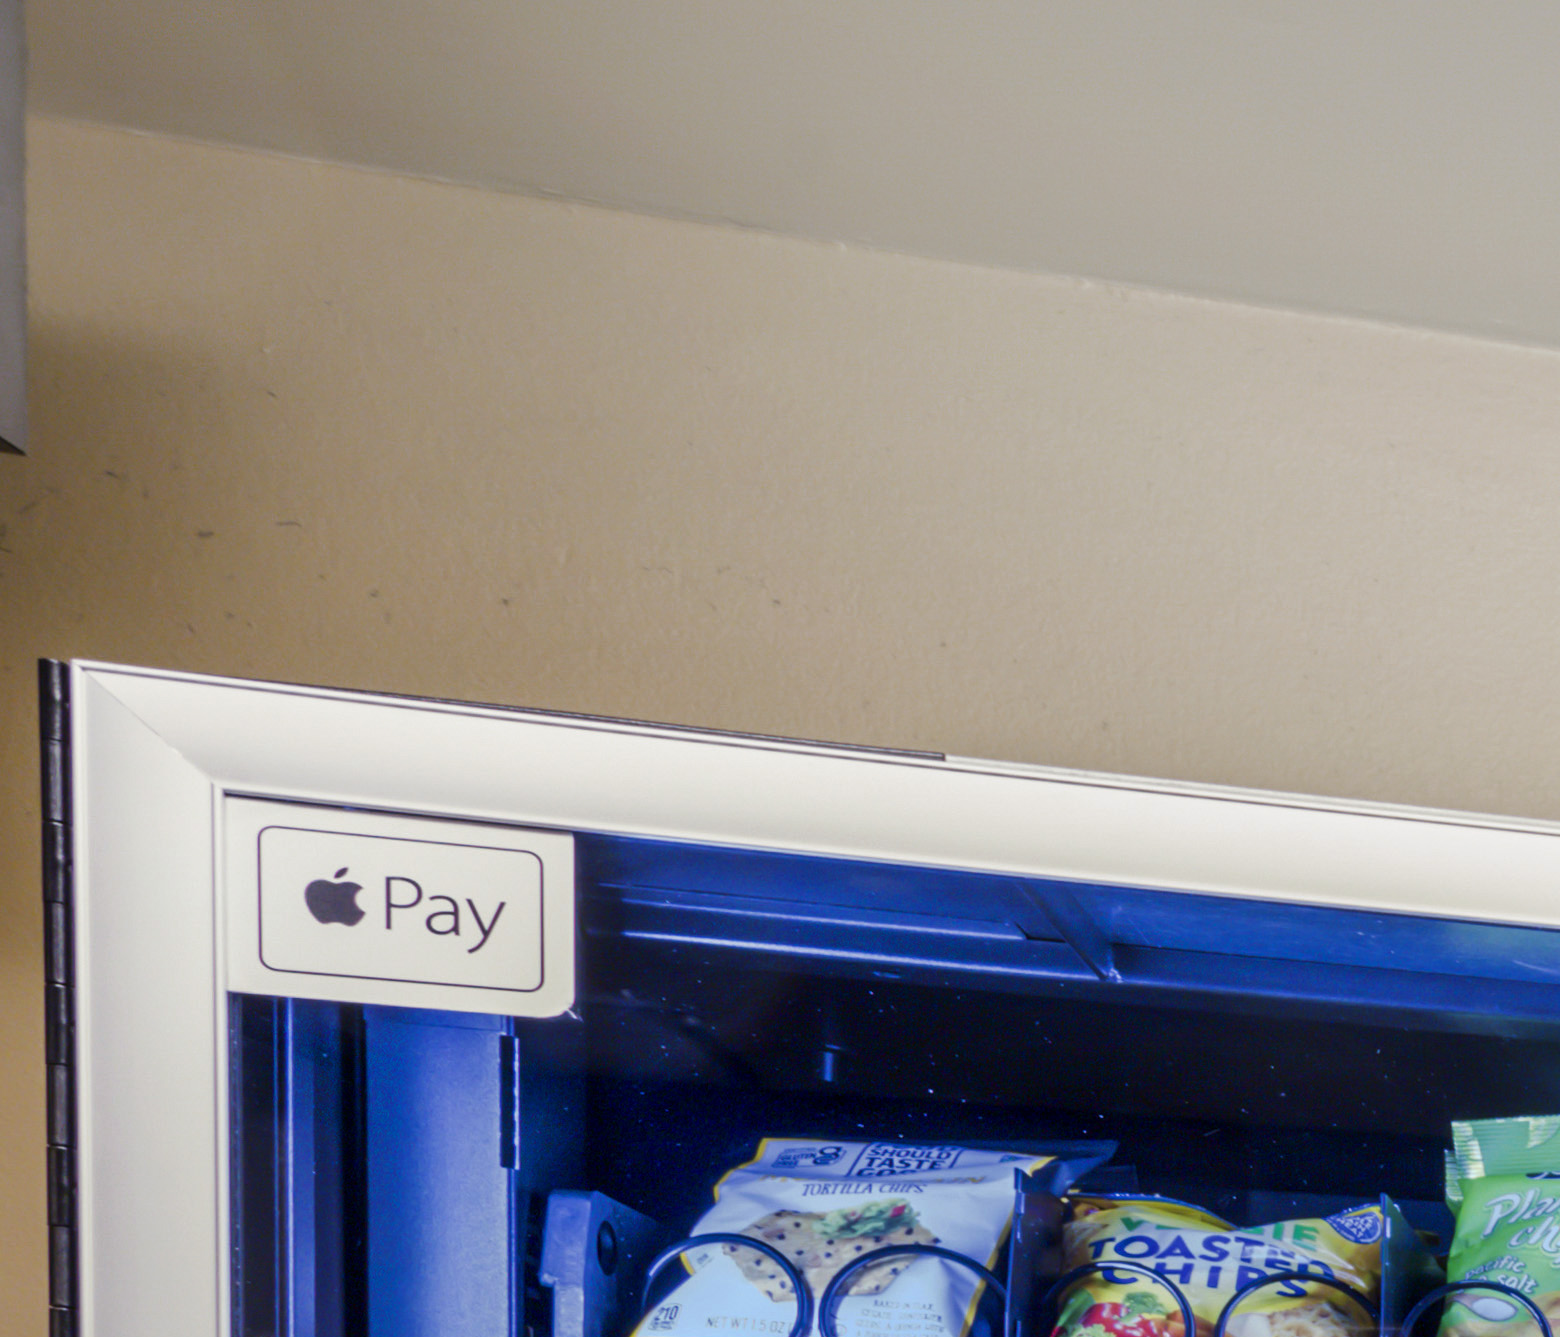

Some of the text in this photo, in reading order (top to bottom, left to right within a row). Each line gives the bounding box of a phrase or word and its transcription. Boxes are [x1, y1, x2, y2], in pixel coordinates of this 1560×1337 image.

[383, 875, 507, 954] Pay
[801, 1183, 928, 1197] TORTILLA CHIPS
